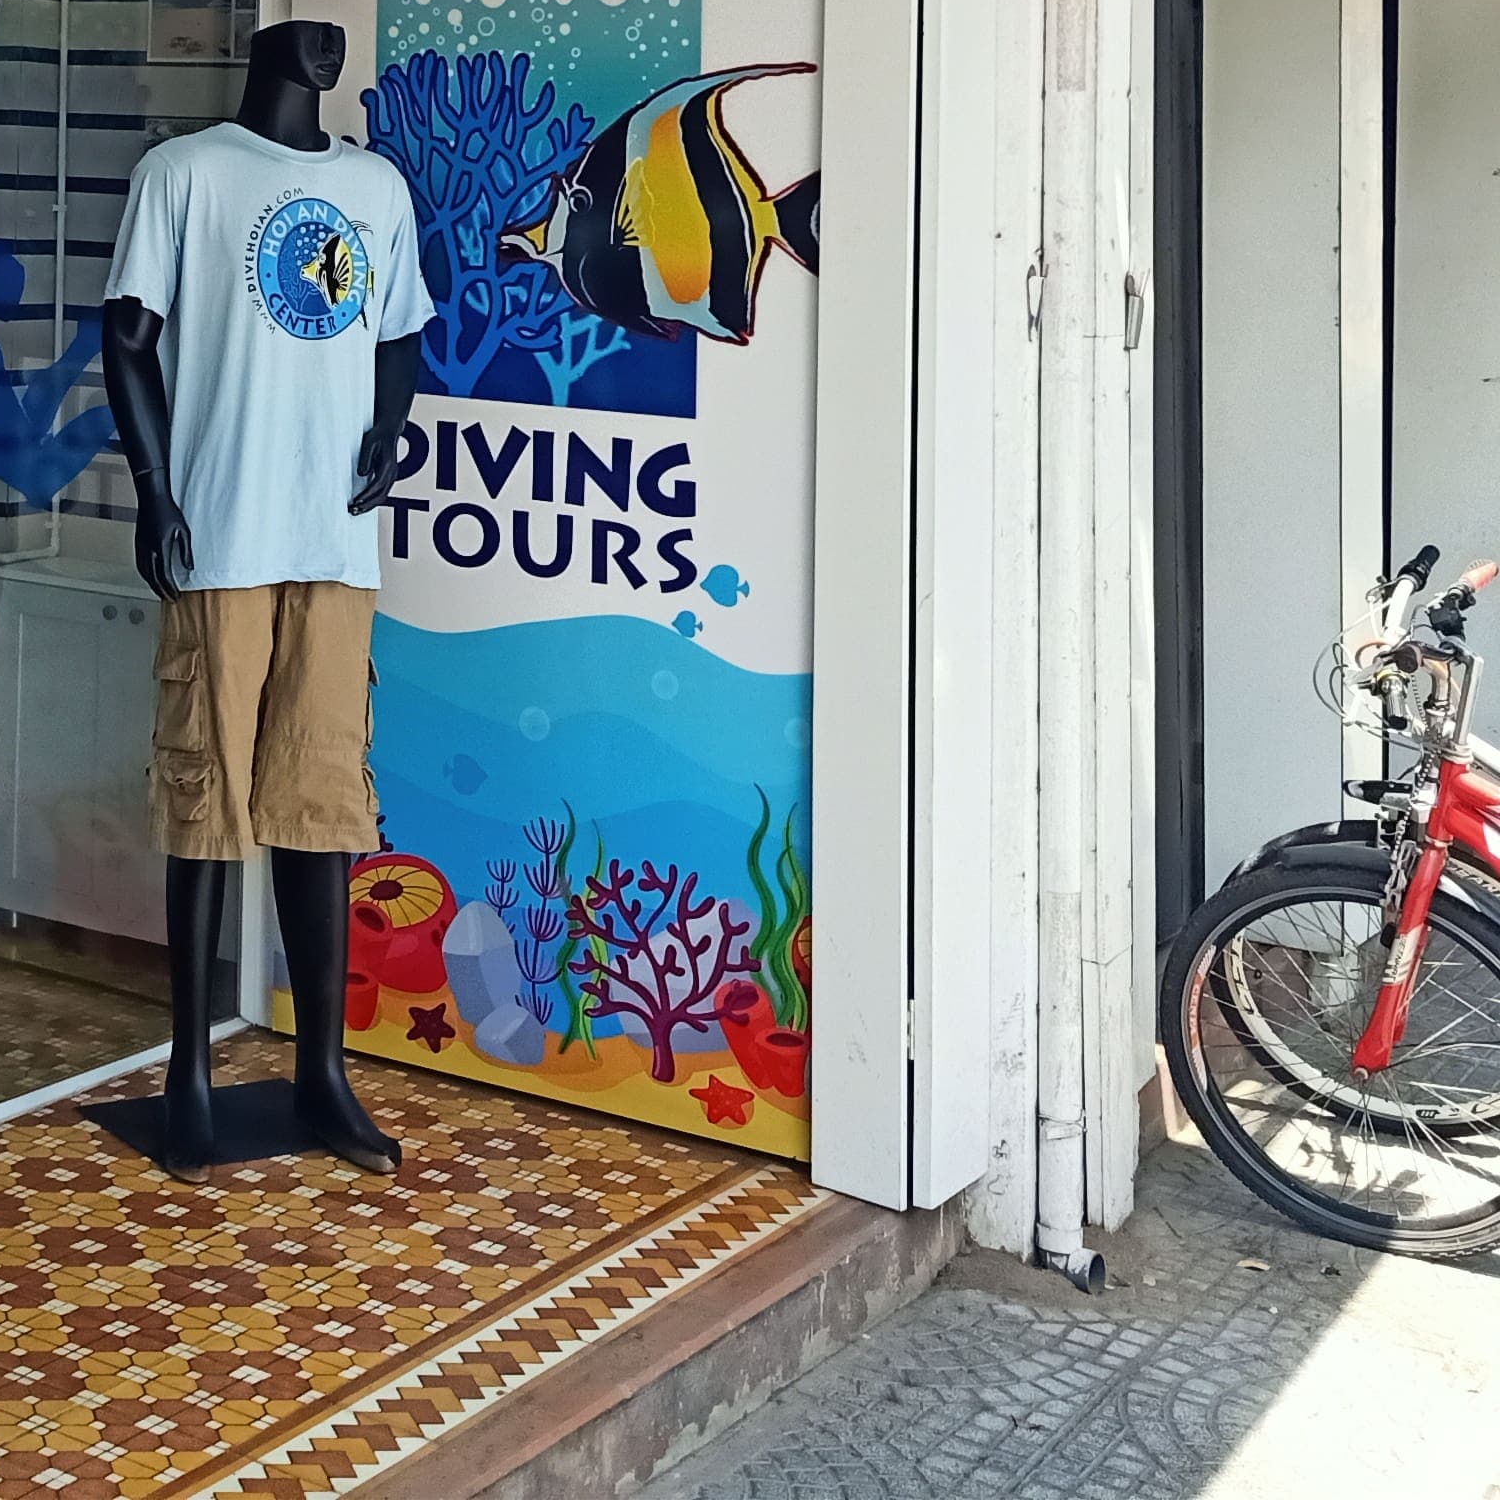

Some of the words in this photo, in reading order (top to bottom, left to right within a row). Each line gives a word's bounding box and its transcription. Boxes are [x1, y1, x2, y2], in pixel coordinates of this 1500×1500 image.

[334, 217, 364, 308] DIVING
[269, 293, 337, 335] CENTER
[394, 419, 697, 518] DIVING
[377, 496, 698, 593] TOURS
